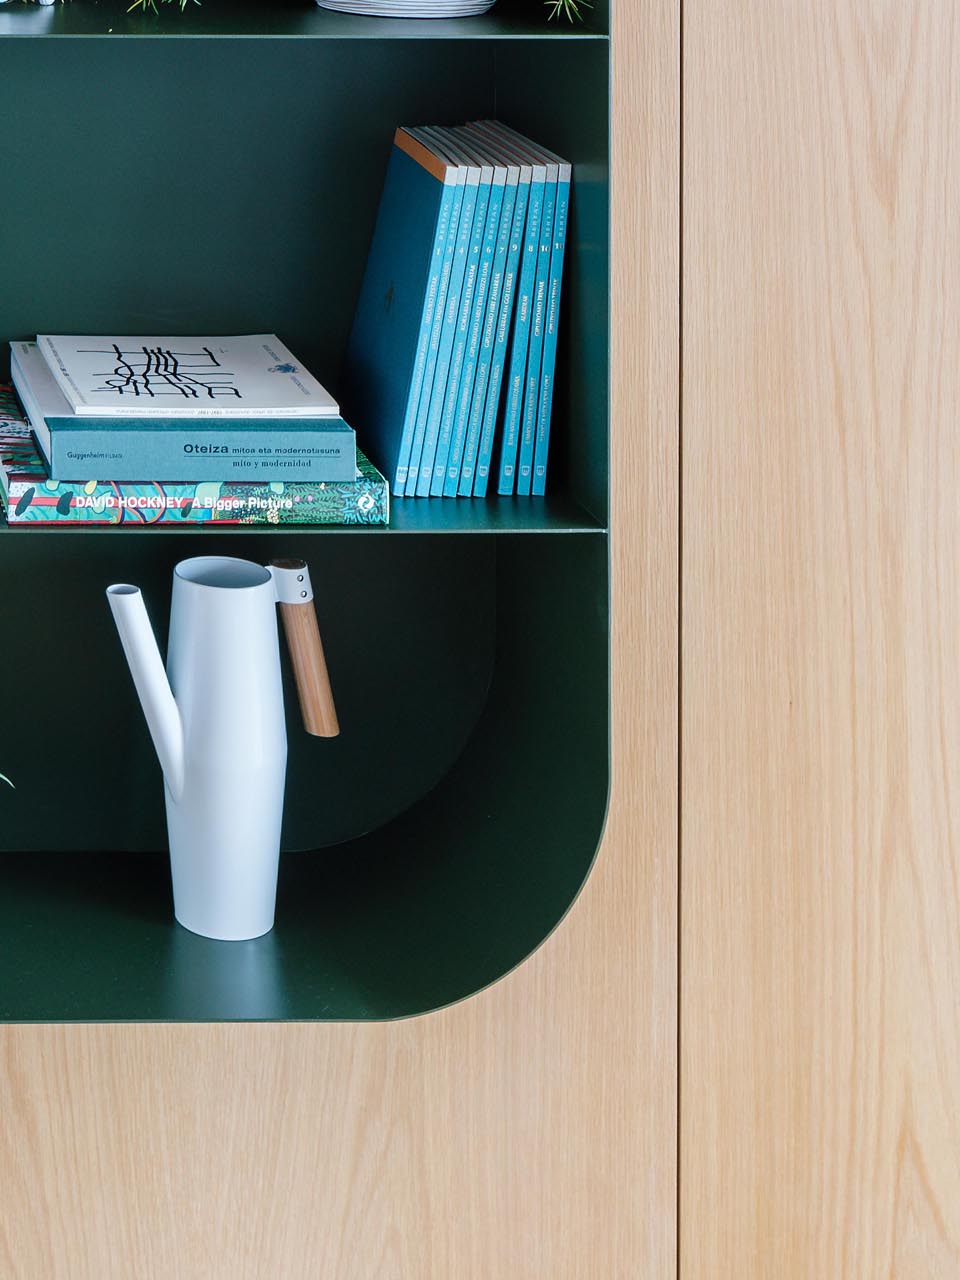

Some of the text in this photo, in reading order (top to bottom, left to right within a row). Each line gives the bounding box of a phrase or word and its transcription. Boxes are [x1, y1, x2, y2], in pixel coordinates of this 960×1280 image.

[437, 204, 448, 241] BERTAN
[448, 203, 459, 240] BERTAN
[461, 203, 471, 240] BERTAN
[474, 203, 484, 239] BERTAN
[487, 203, 497, 239] BERTAN
[501, 202, 510, 239] BERTAN
[514, 202, 522, 239] BERTAN
[530, 202, 539, 238] BERTAN
[484, 313, 495, 348] GIPUZKOAKO
[534, 301, 542, 336] GIPUZKOAKO
[67, 452, 104, 460] Guggenheim
[184, 444, 228, 454] Oteiza
[262, 459, 312, 467] modernidad
[76, 496, 292, 511] DAVID HOCKNEY A Bigger Picture
